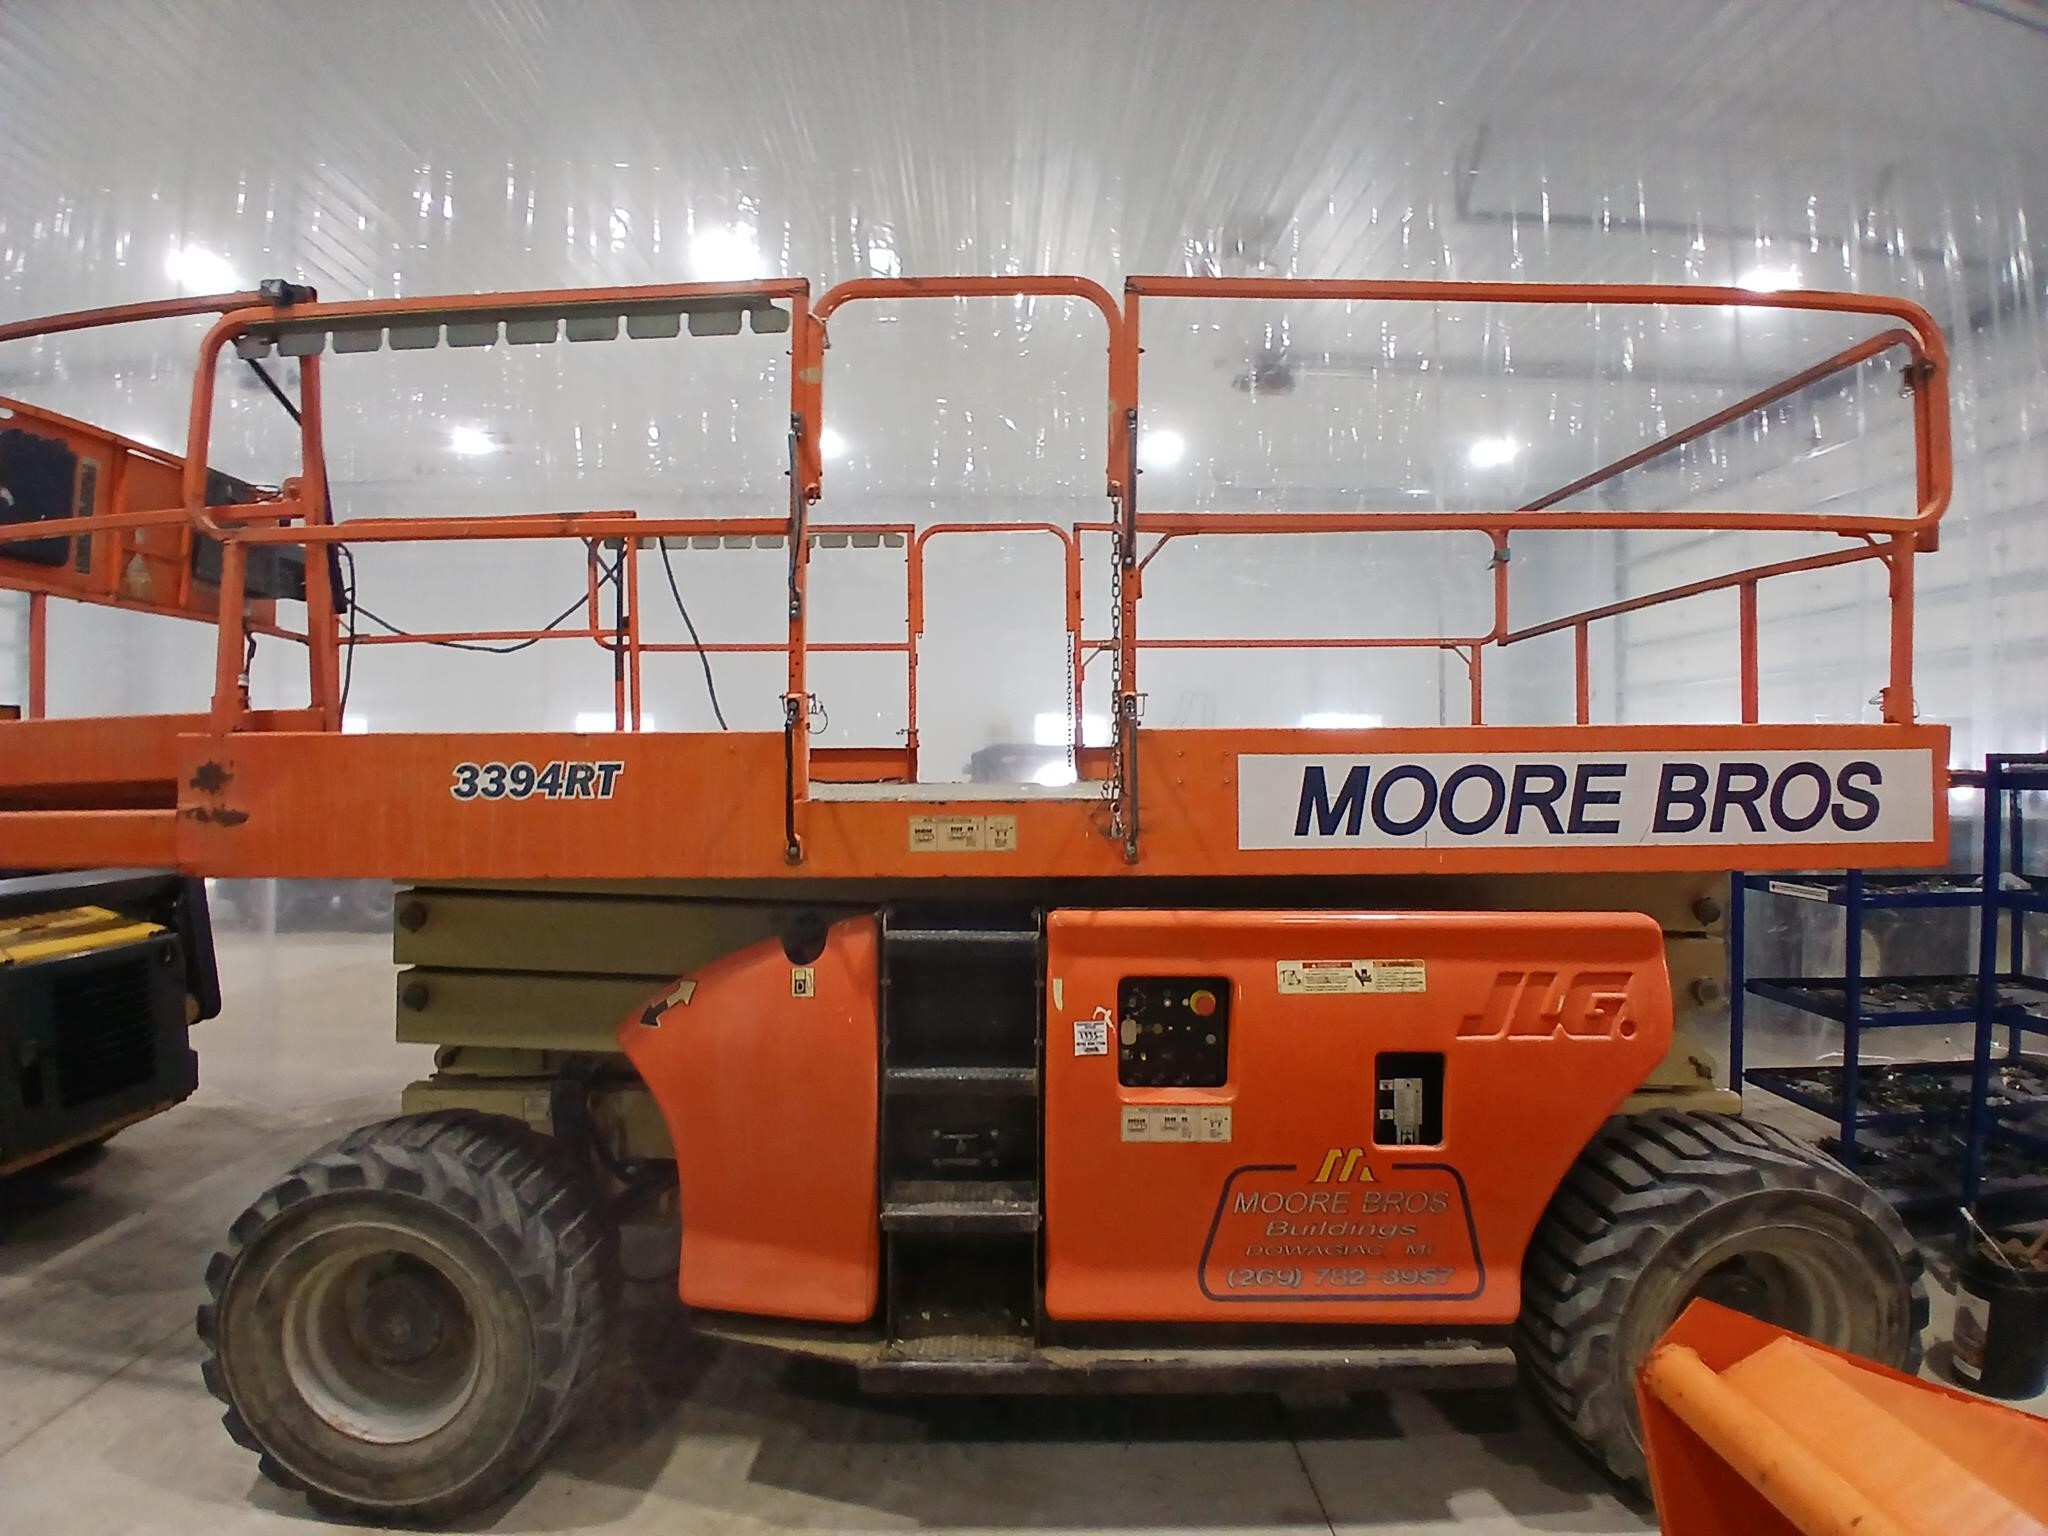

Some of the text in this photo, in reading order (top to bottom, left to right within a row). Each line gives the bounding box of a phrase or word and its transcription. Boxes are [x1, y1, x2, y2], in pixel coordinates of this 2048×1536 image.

[452, 762, 623, 799] 3394RT
[1295, 762, 1882, 836] MOORE BROS
[1233, 1191, 1449, 1214] MOORE BROS
[1266, 1220, 1417, 1239] Buildings
[1226, 1268, 1303, 1287] (269)
